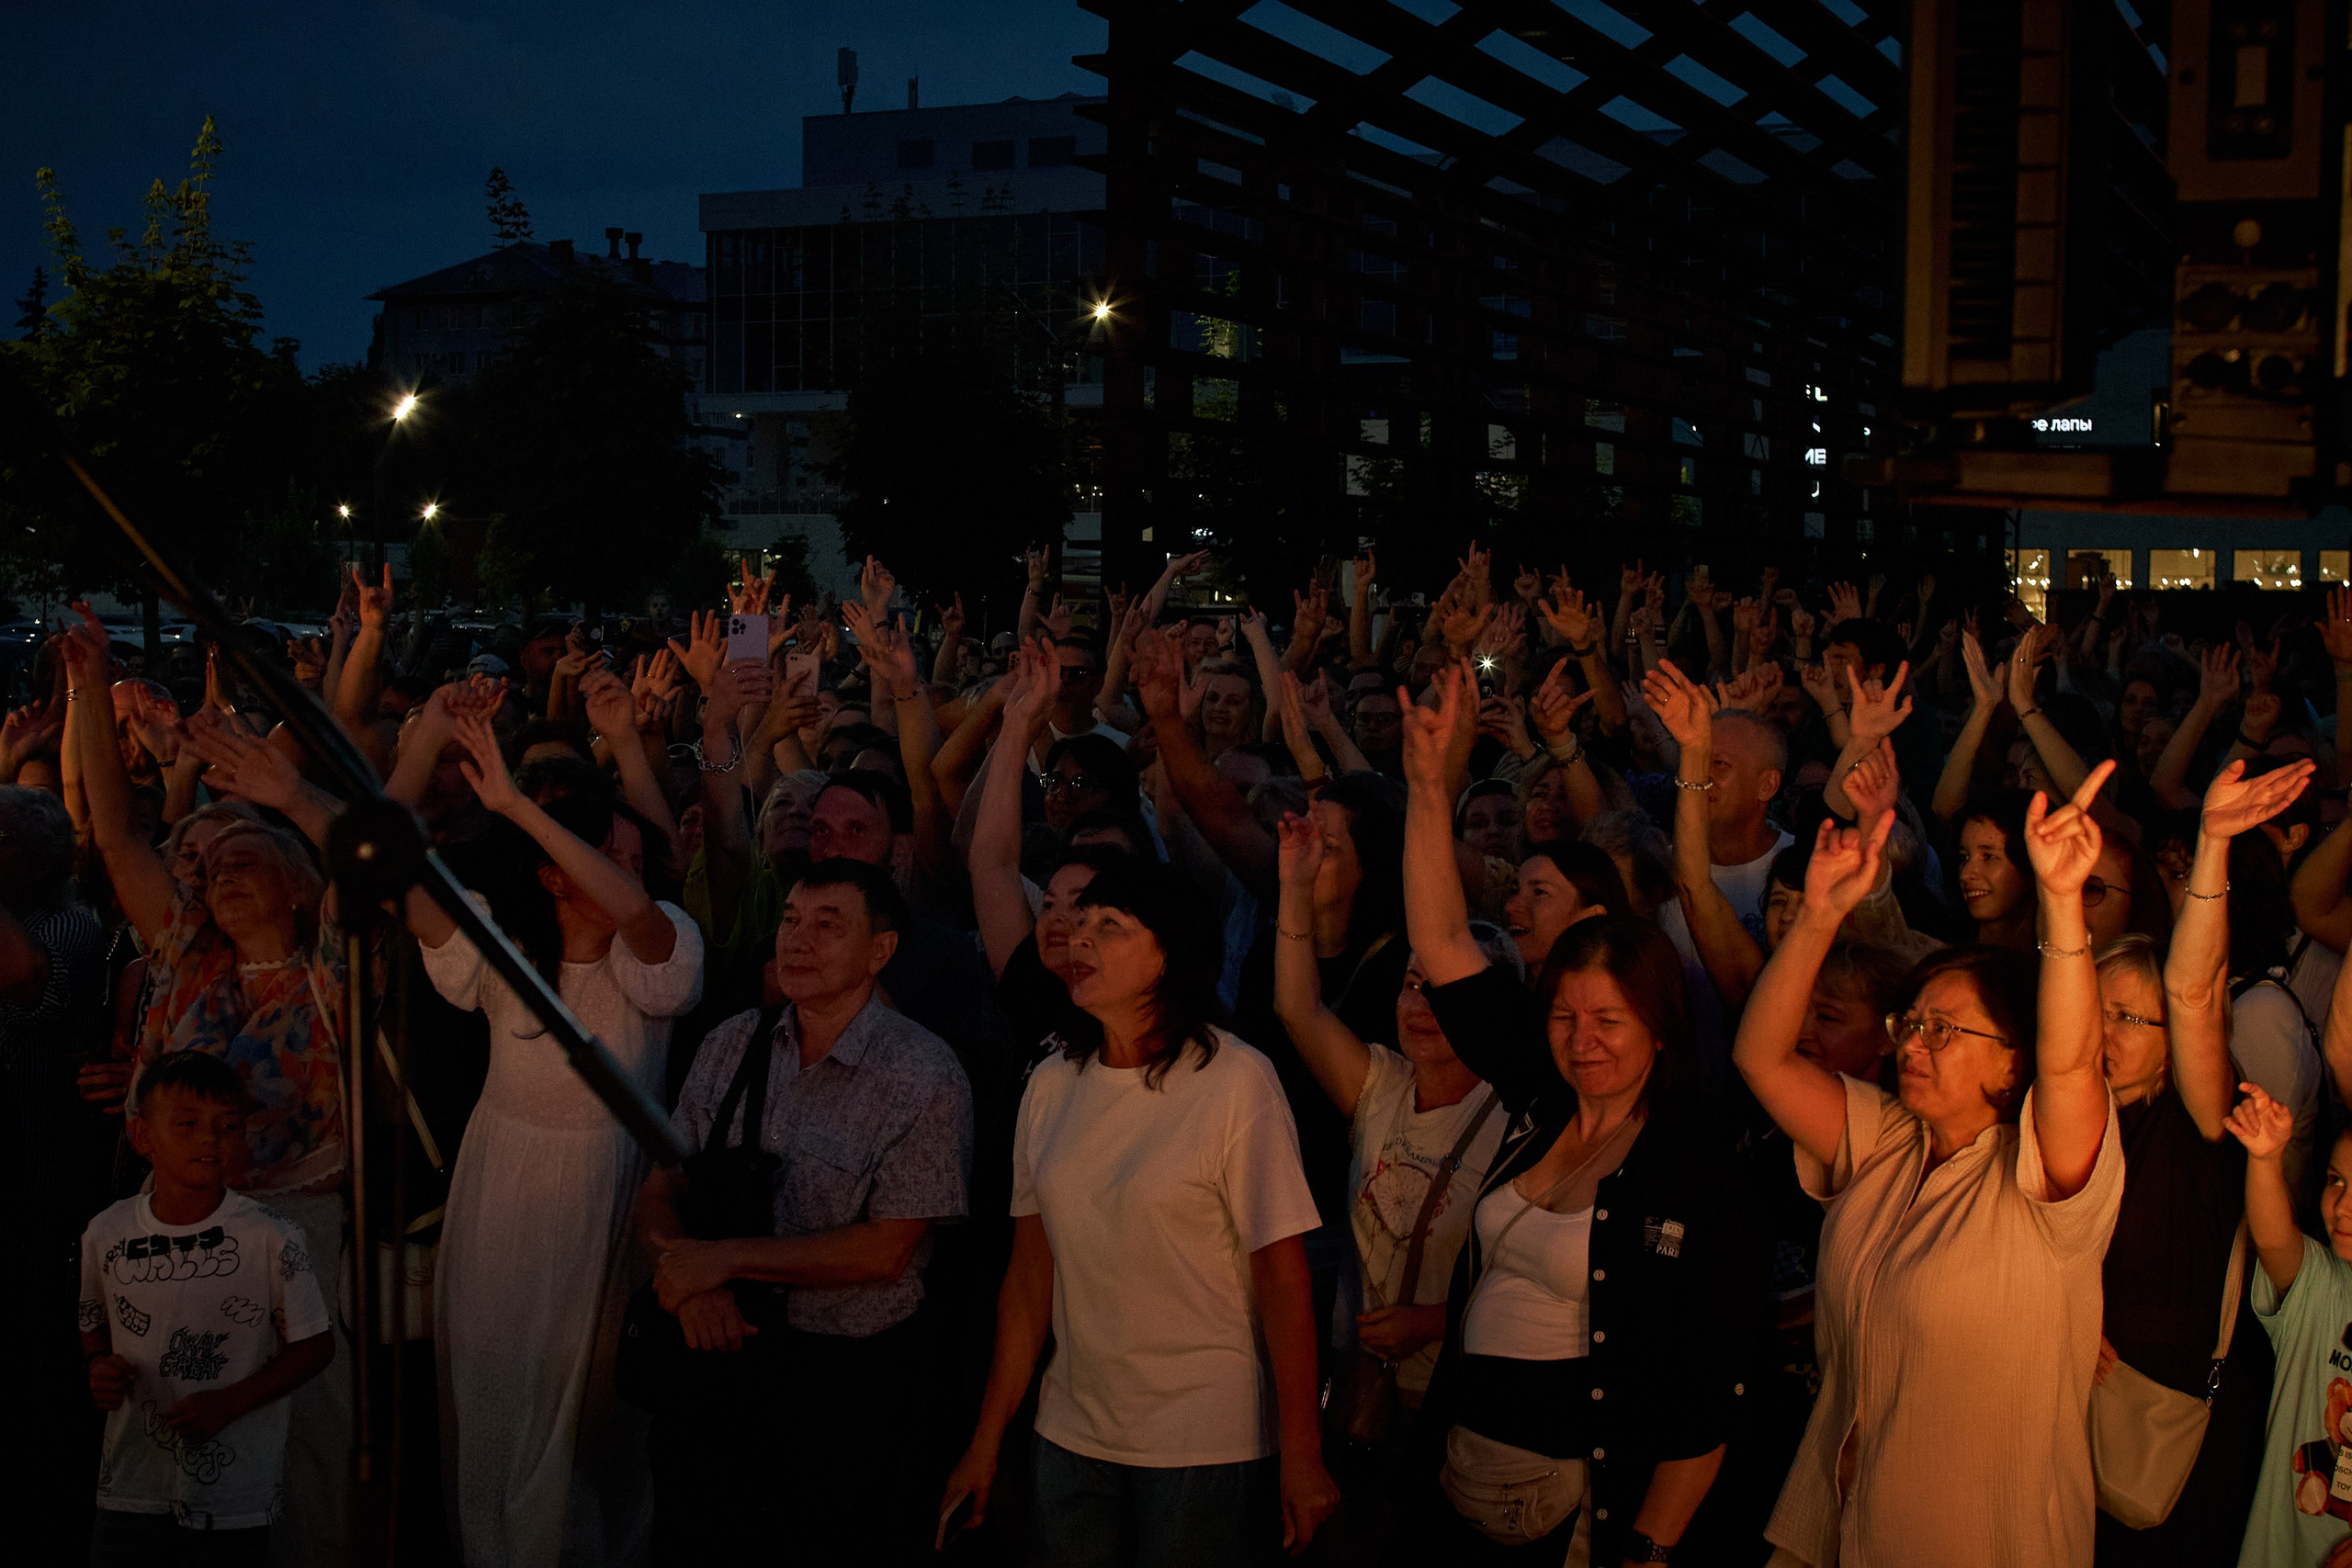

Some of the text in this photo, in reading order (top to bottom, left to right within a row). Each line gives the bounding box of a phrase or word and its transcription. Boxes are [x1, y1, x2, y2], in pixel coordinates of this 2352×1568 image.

[2050, 418, 2093, 432] лапы
[169, 1325, 230, 1359] OKAY
[159, 1351, 230, 1381] GREAT
[2336, 1481, 2351, 1492] TOY
